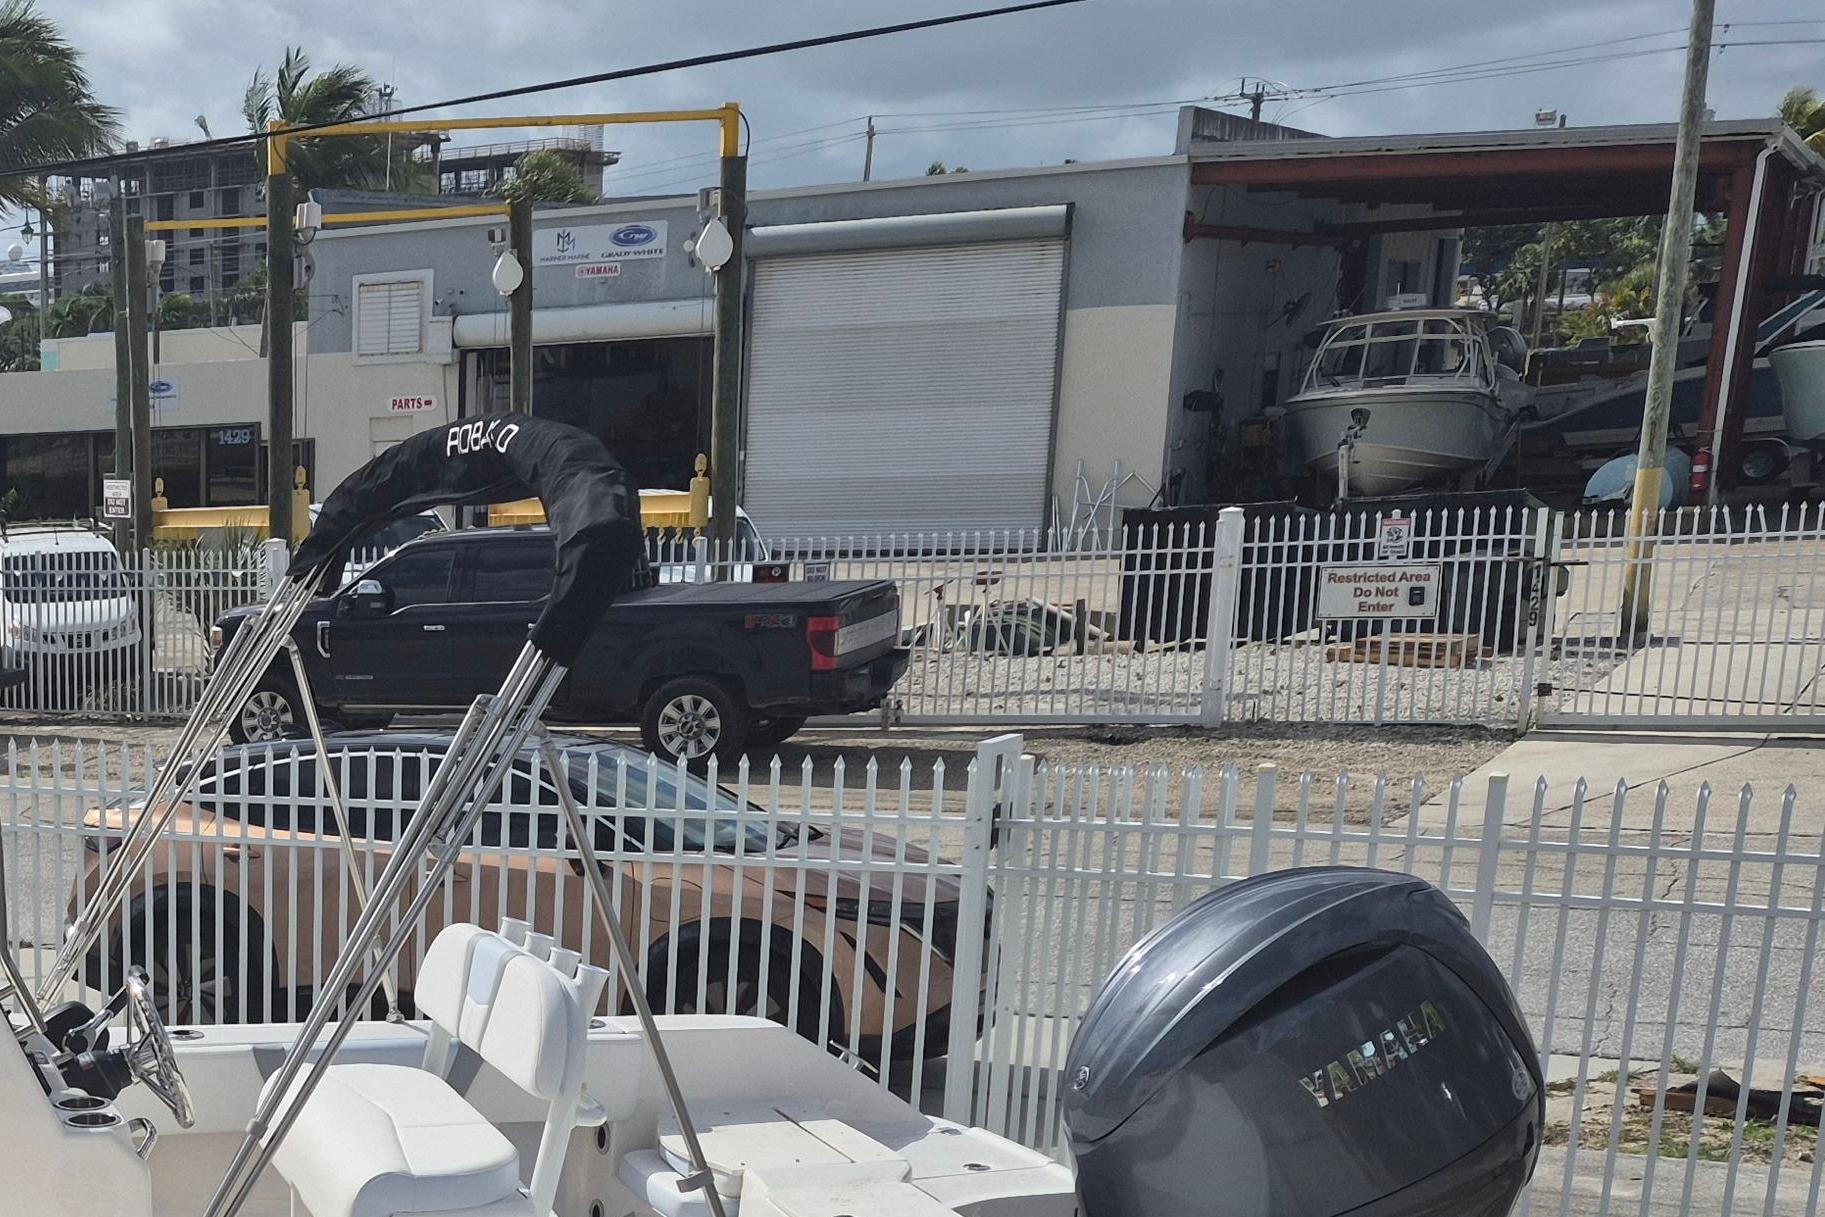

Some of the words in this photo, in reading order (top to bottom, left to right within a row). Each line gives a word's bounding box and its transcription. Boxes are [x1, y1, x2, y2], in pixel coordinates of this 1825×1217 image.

[601, 248, 663, 258] GRADY-WHITE
[586, 265, 618, 275] YAMAHA
[392, 397, 423, 410] PARTS
[219, 429, 250, 444] 1429
[1328, 572, 1396, 583] Restricted
[1398, 571, 1431, 582] Area
[1353, 587, 1372, 598] Do
[1375, 586, 1399, 598] Not
[1528, 564, 1542, 627] 1429
[1358, 601, 1396, 613] Enter
[1299, 1000, 1445, 1108] YAMAHA
